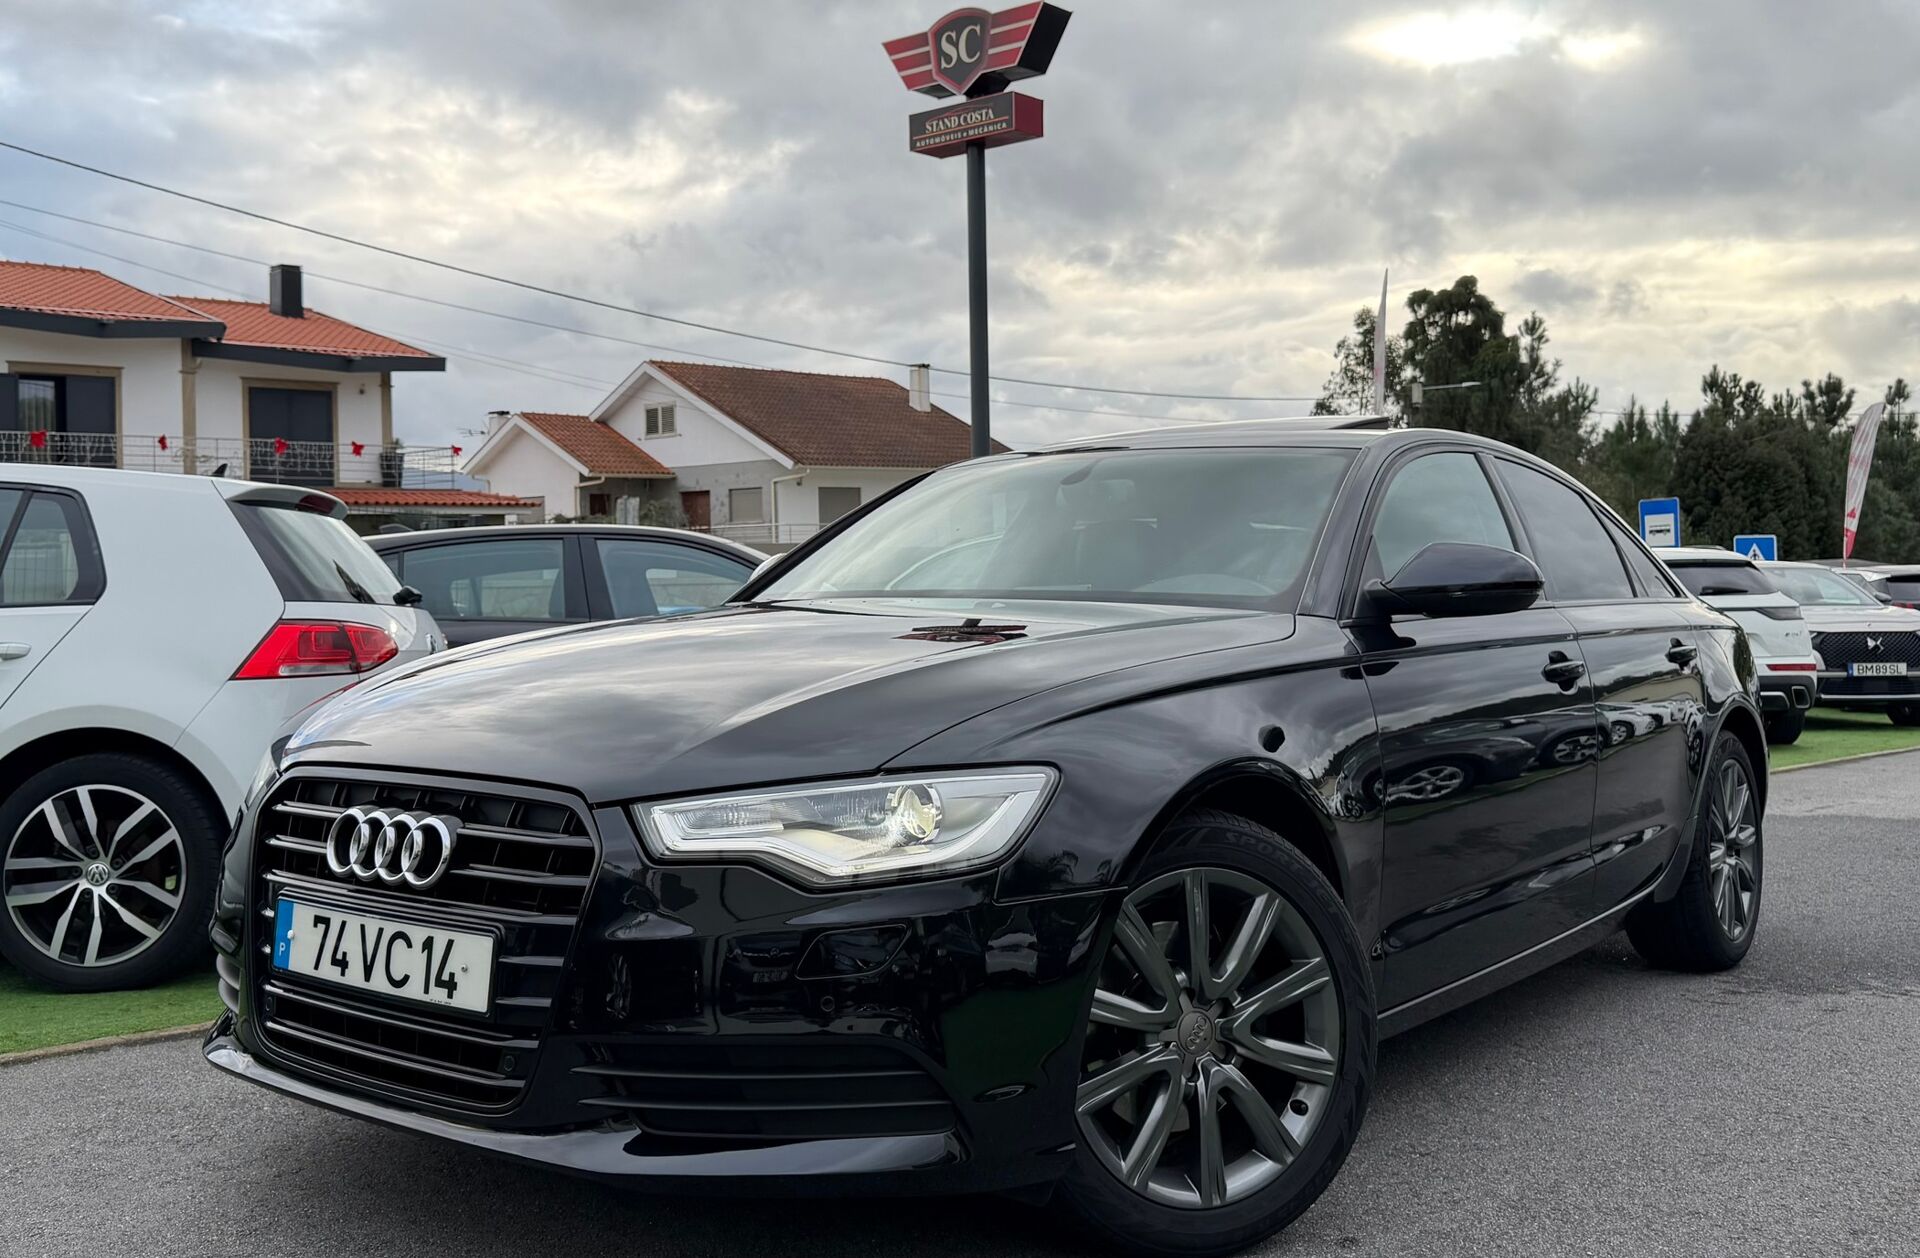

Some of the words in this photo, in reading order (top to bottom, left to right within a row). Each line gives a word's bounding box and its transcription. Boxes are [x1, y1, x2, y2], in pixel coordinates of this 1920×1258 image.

[940, 24, 981, 69] SC
[925, 117, 958, 133] STAND
[960, 108, 994, 125] COSTA
